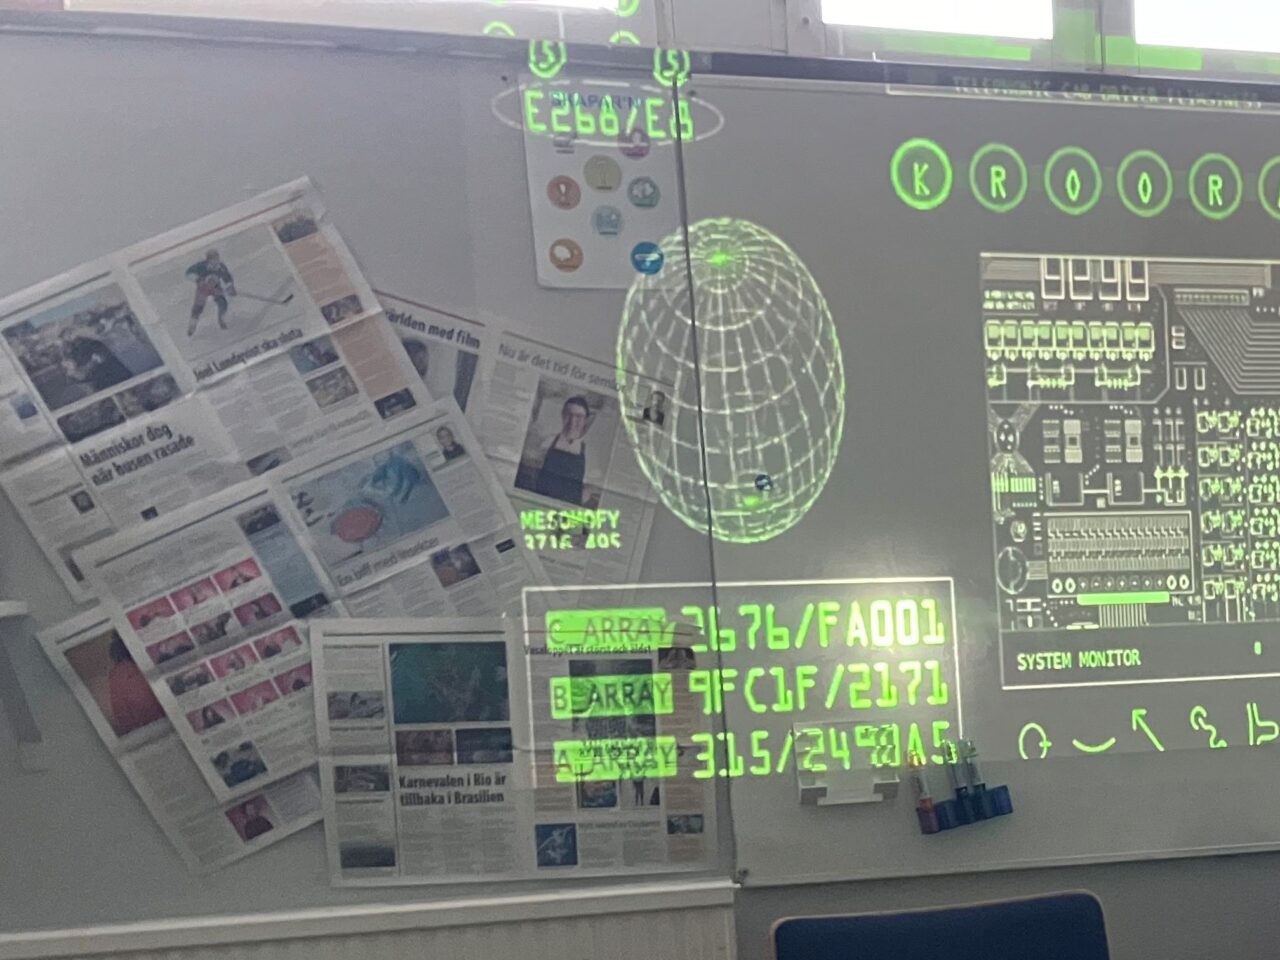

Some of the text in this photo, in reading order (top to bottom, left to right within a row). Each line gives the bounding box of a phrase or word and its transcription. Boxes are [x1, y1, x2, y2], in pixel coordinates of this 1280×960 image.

[427, 324, 455, 342] med
[455, 329, 481, 350] film
[1016, 648, 1142, 672] SYSTEM MONITOR
[398, 774, 465, 789] Karnevalen
[473, 772, 492, 787] Rio
[400, 791, 446, 807] tillbaka
[454, 789, 505, 805] Brasilien
